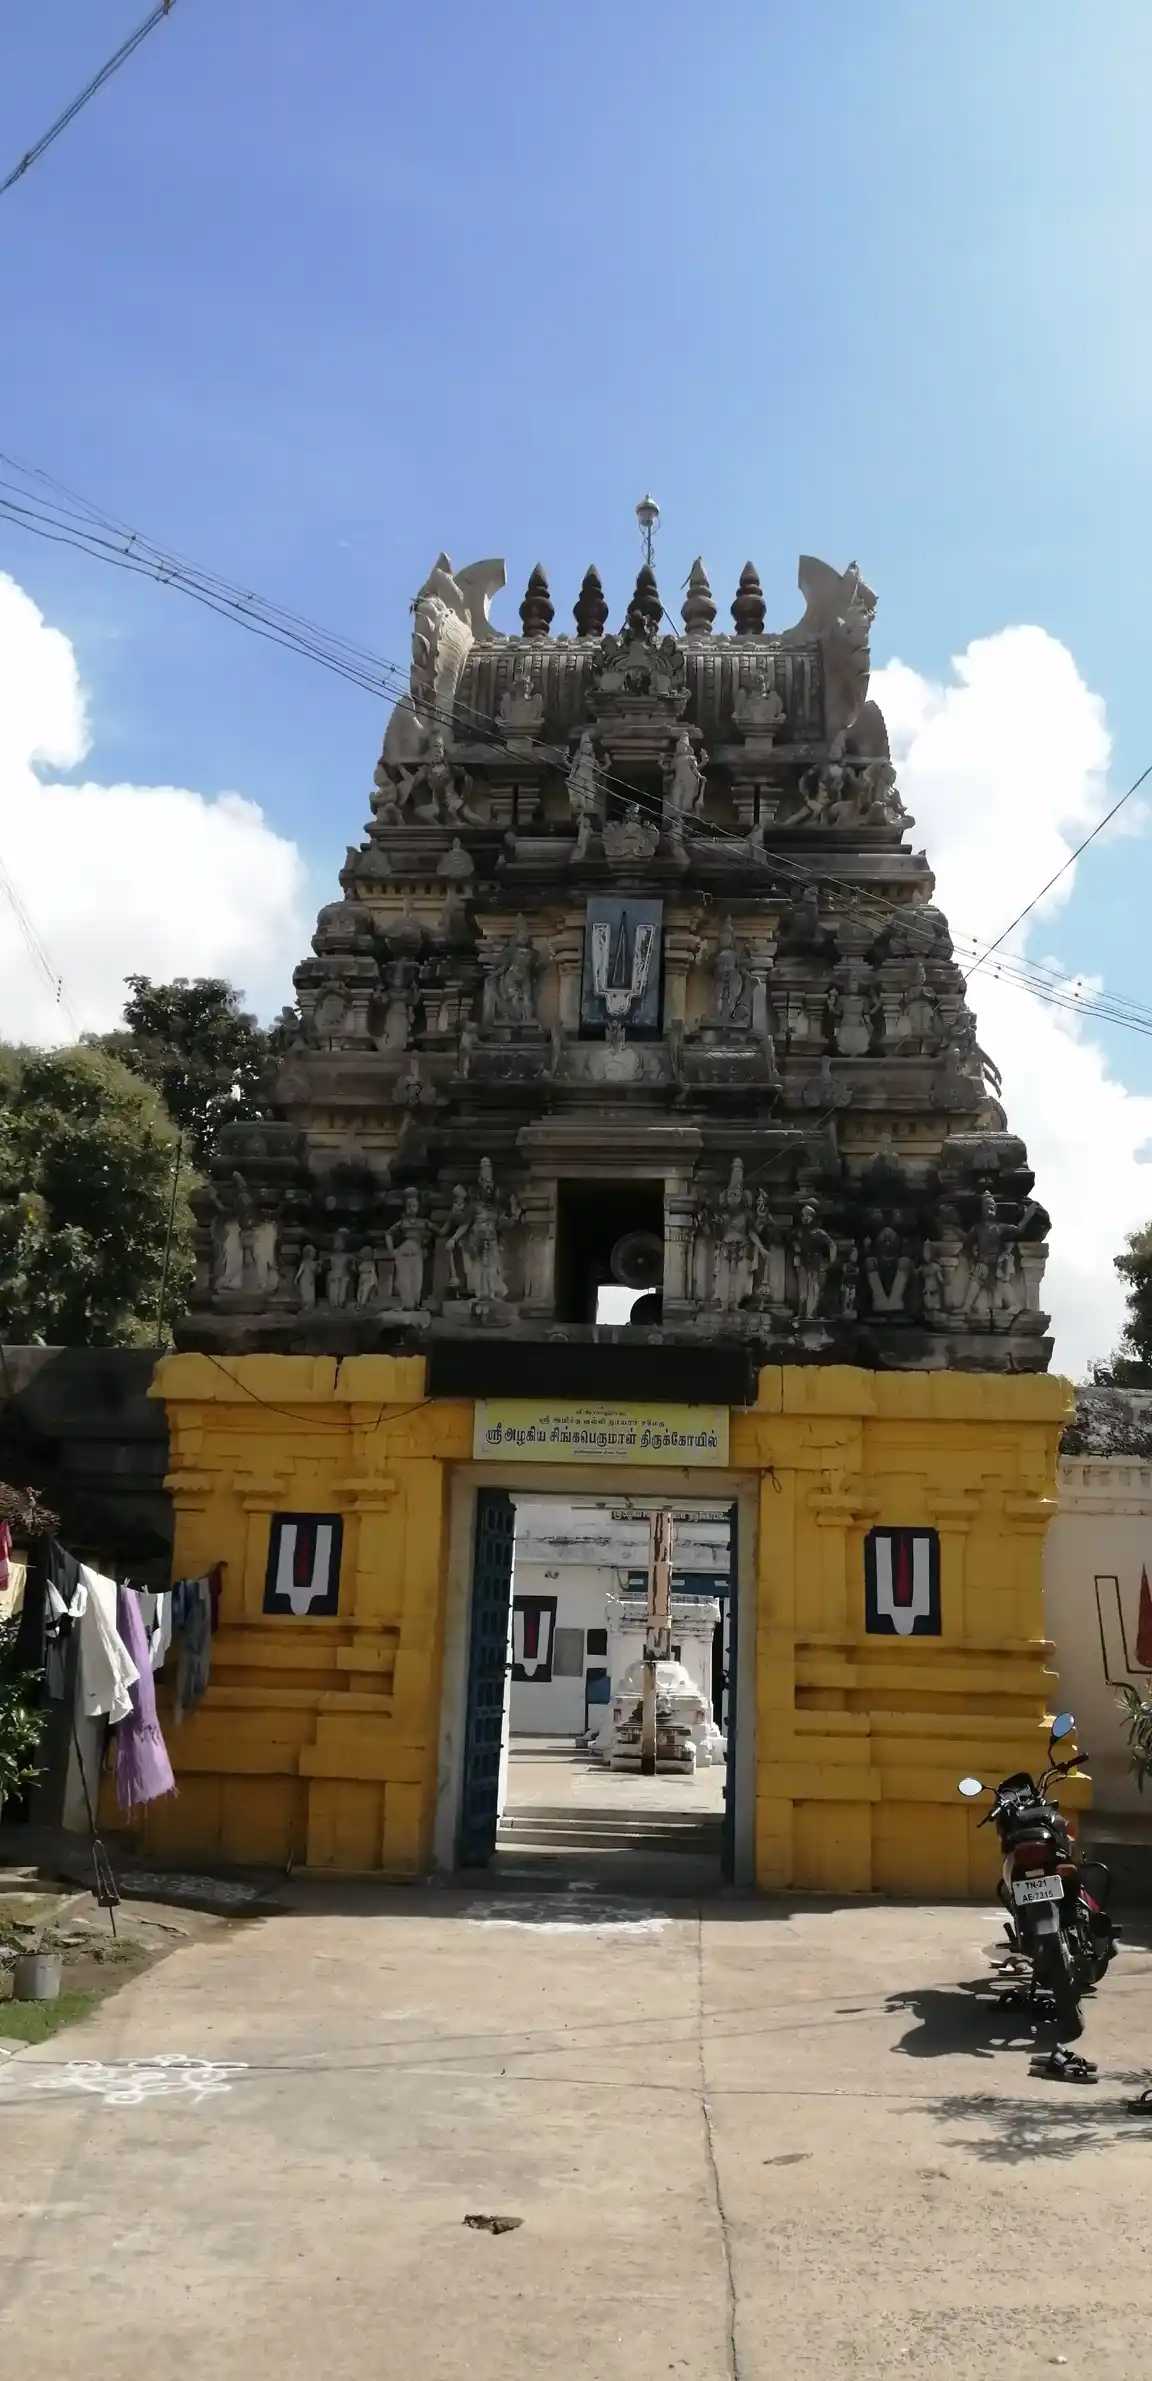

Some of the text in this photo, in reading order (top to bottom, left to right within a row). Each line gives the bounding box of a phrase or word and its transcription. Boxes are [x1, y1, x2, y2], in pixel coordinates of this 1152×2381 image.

[504, 1425, 546, 1447] அழகிய
[550, 1426, 637, 1448] சிங்கபெருமாள்
[640, 1427, 719, 1449] திருக்கோயில்
